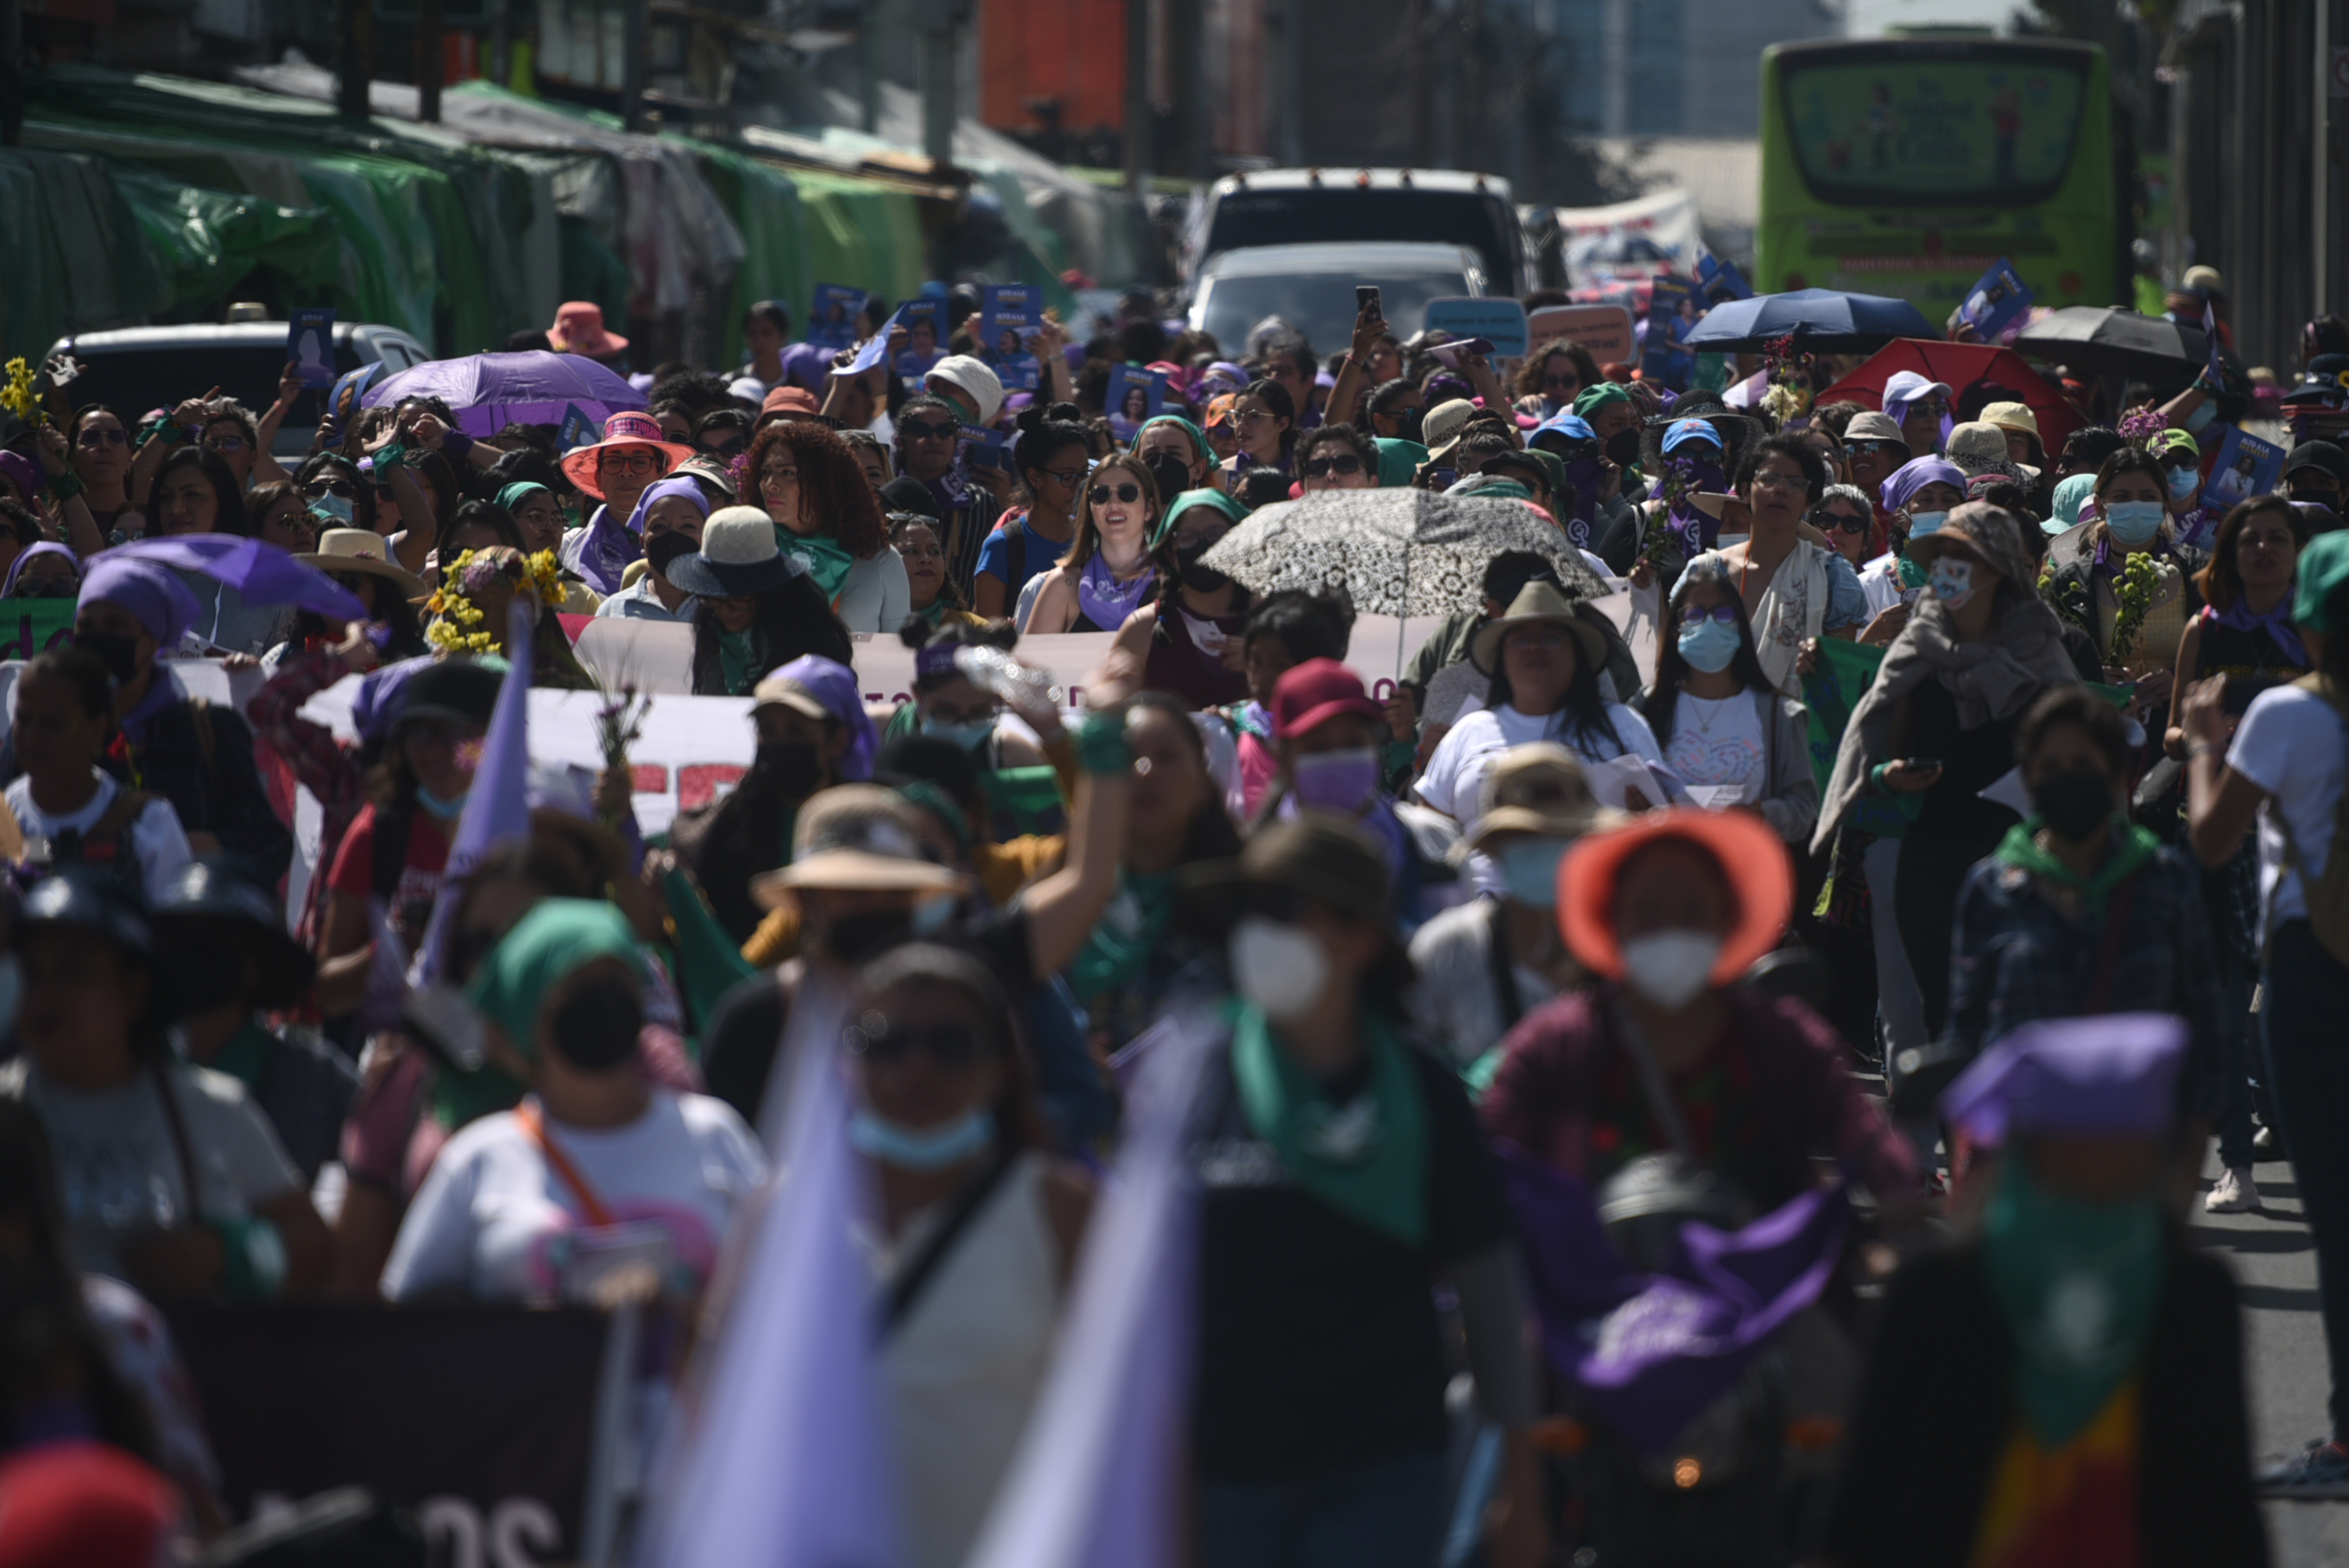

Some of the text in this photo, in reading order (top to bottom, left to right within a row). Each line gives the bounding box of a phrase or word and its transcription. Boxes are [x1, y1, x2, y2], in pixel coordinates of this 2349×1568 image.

[2240, 437, 2257, 448] ALTO
[2256, 443, 2263, 451] A
[2262, 444, 2270, 454] LA
